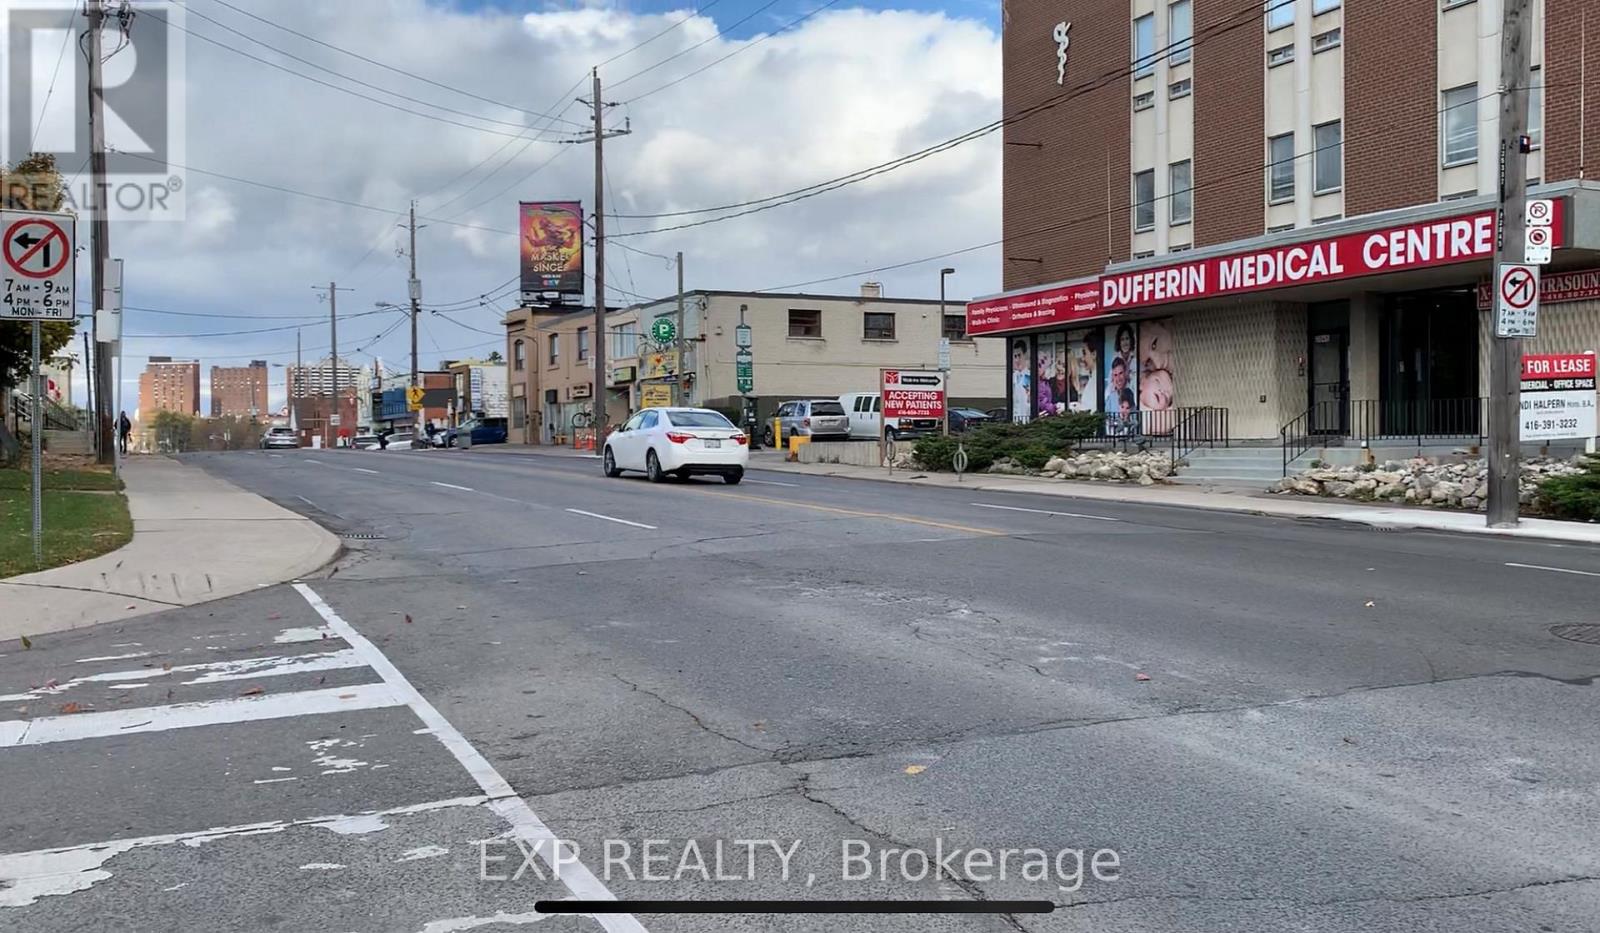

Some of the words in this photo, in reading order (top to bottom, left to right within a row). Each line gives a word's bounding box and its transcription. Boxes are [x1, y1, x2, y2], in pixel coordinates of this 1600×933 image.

[1103, 264, 1205, 307] DUFFERIN
[1219, 242, 1344, 290] MEDICAL
[1363, 216, 1492, 269] CENTRE
[5, 279, 14, 291] 7
[44, 280, 53, 293] 9
[3, 293, 13, 305] 4
[43, 294, 53, 307] 6
[1527, 360, 1550, 373] FOR
[1553, 358, 1591, 373] LEASE
[1553, 379, 1574, 389] OFFICE
[1574, 378, 1594, 388] SPACE
[888, 391, 938, 400] ACCEPTING
[884, 400, 904, 409] NEW
[905, 400, 942, 409] PATIENTS
[1533, 399, 1566, 410] HALPERN
